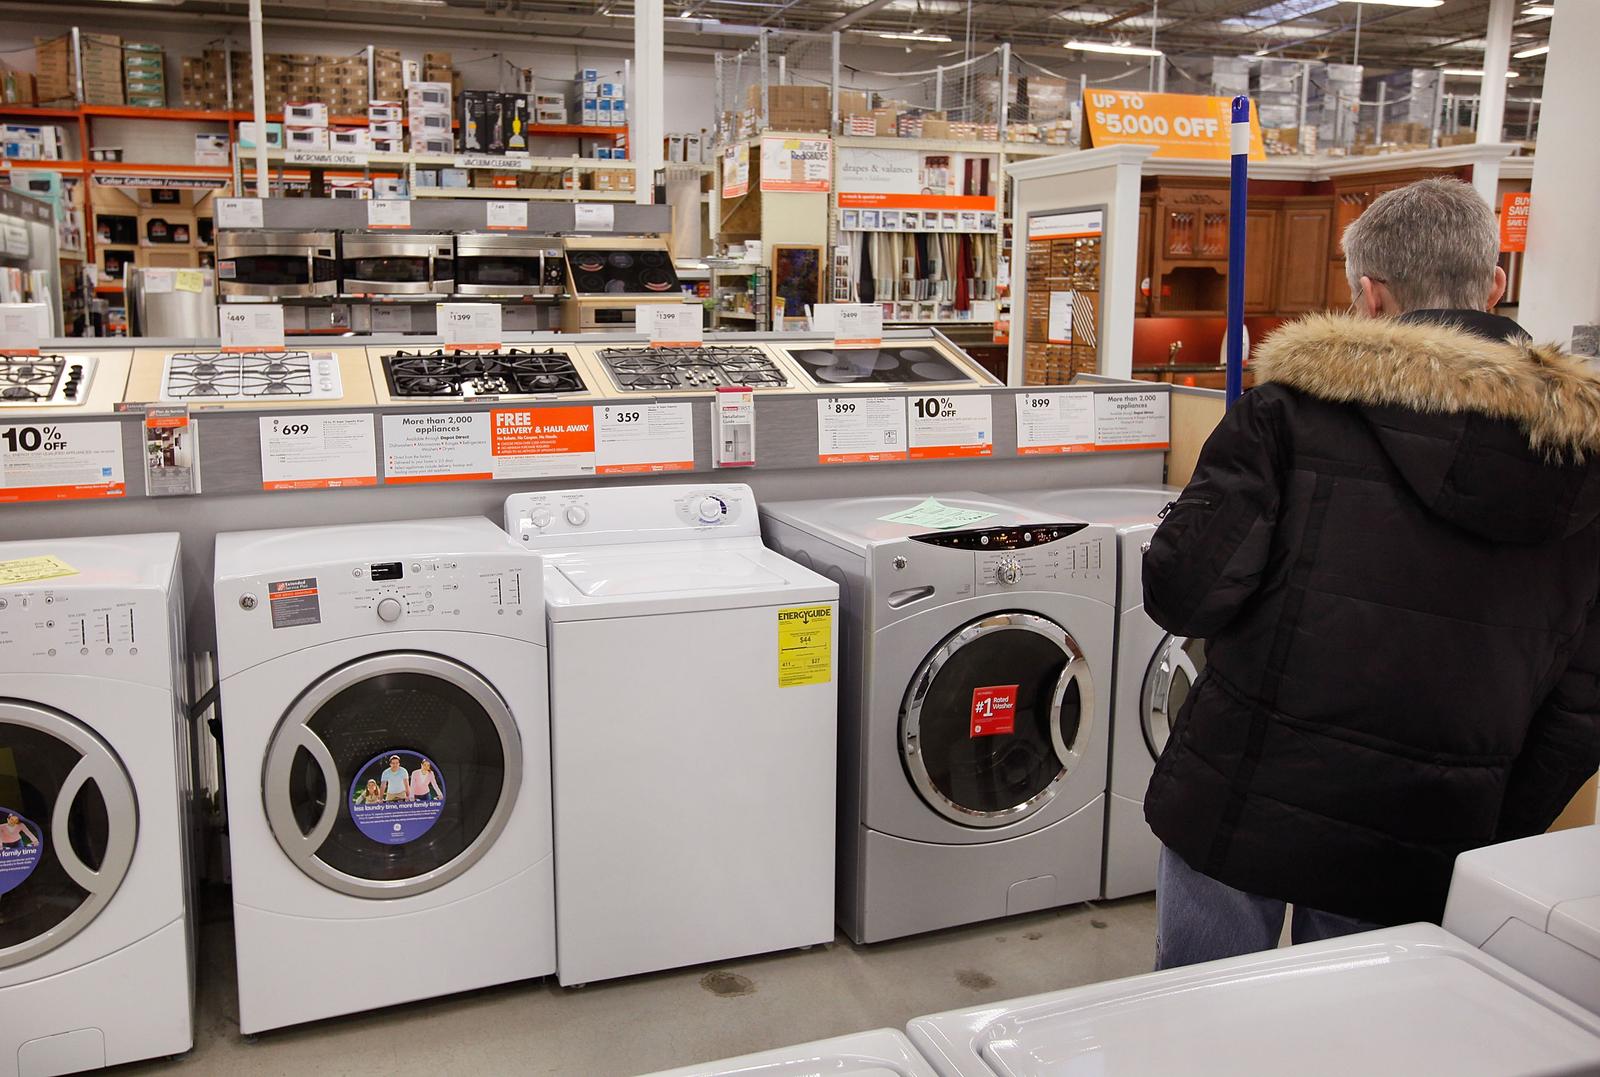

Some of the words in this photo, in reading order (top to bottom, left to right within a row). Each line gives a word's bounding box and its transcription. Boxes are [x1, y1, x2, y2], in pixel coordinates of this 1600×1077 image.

[1091, 93, 1116, 108] UP
[1120, 95, 1144, 110] TO
[1095, 111, 1169, 136] $5,000
[1173, 116, 1219, 138] OFF
[842, 163, 869, 174] drapes
[871, 164, 878, 172] &
[881, 164, 913, 173] valances
[125, 178, 163, 186] Collection
[835, 403, 856, 413] 899
[1031, 398, 1050, 408] 899
[1117, 402, 1147, 410] appliances
[448, 416, 473, 424] 2,000
[496, 412, 531, 426] FREE
[617, 412, 640, 422] 359
[282, 424, 309, 435] 699
[416, 425, 460, 434] appliances
[496, 426, 533, 435] DELIVERY
[543, 425, 565, 433] HAUL
[566, 424, 589, 432] AWAY
[44, 442, 67, 451] OFF
[778, 608, 831, 621] ENERGYGUIDE
[975, 697, 993, 717] #1
[413, 801, 428, 809] family
